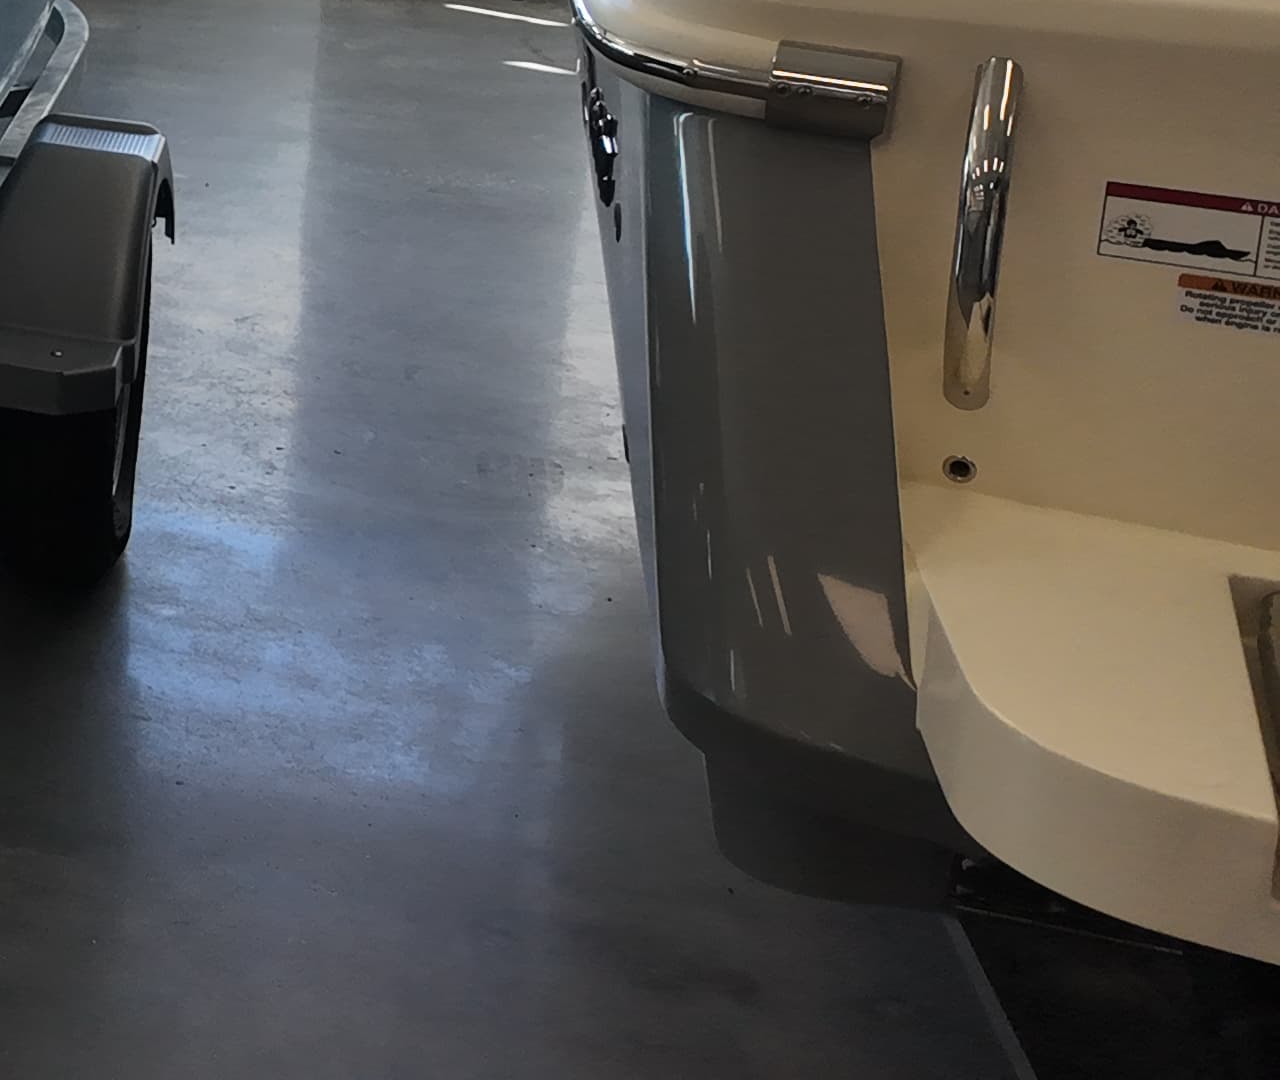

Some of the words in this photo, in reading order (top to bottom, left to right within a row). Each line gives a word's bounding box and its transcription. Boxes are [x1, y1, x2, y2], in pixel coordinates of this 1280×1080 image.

[1257, 203, 1280, 215] DA
[1185, 290, 1227, 305] Rotating
[1180, 304, 1194, 314] Do
[1197, 307, 1213, 316] not
